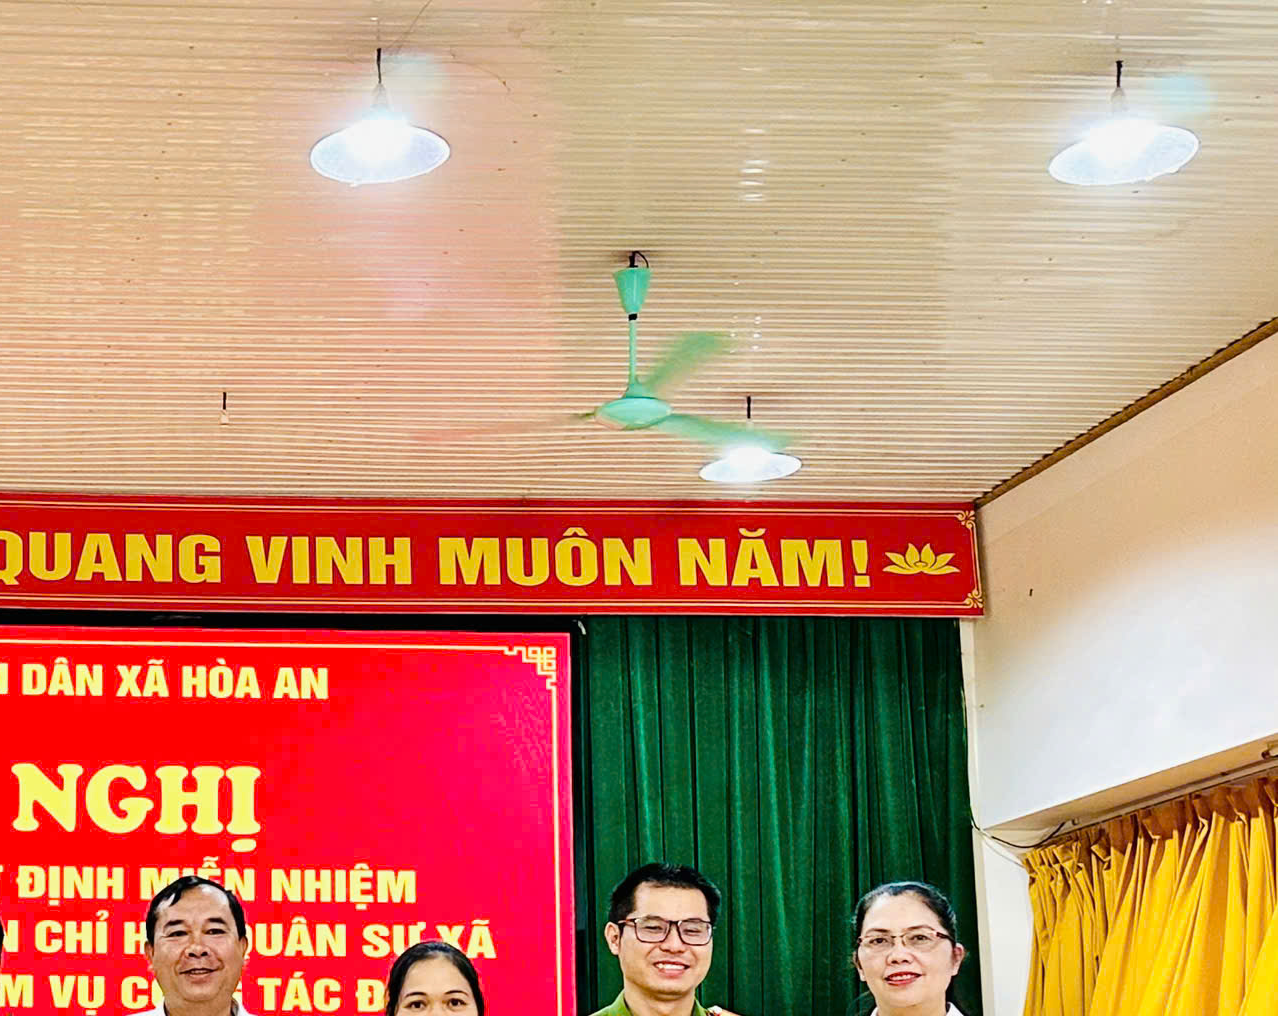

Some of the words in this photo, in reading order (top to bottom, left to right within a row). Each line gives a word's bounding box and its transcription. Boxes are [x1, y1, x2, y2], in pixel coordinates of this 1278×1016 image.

[245, 535, 412, 585] VINH
[438, 527, 653, 587] MUÔN
[677, 527, 871, 588] NĂM!
[21, 656, 103, 697] DÂN
[116, 658, 169, 698] XÃ
[181, 658, 262, 699] HÒA
[273, 667, 329, 700] AN
[11, 762, 262, 853] NGHỊ
[15, 865, 125, 906] ĐỊNH
[271, 862, 417, 911] NHIỆM
[34, 909, 110, 954] CHỈ
[435, 919, 497, 959] XÃ
[48, 975, 106, 1016] VỤ
[257, 971, 341, 1013] TÁC
